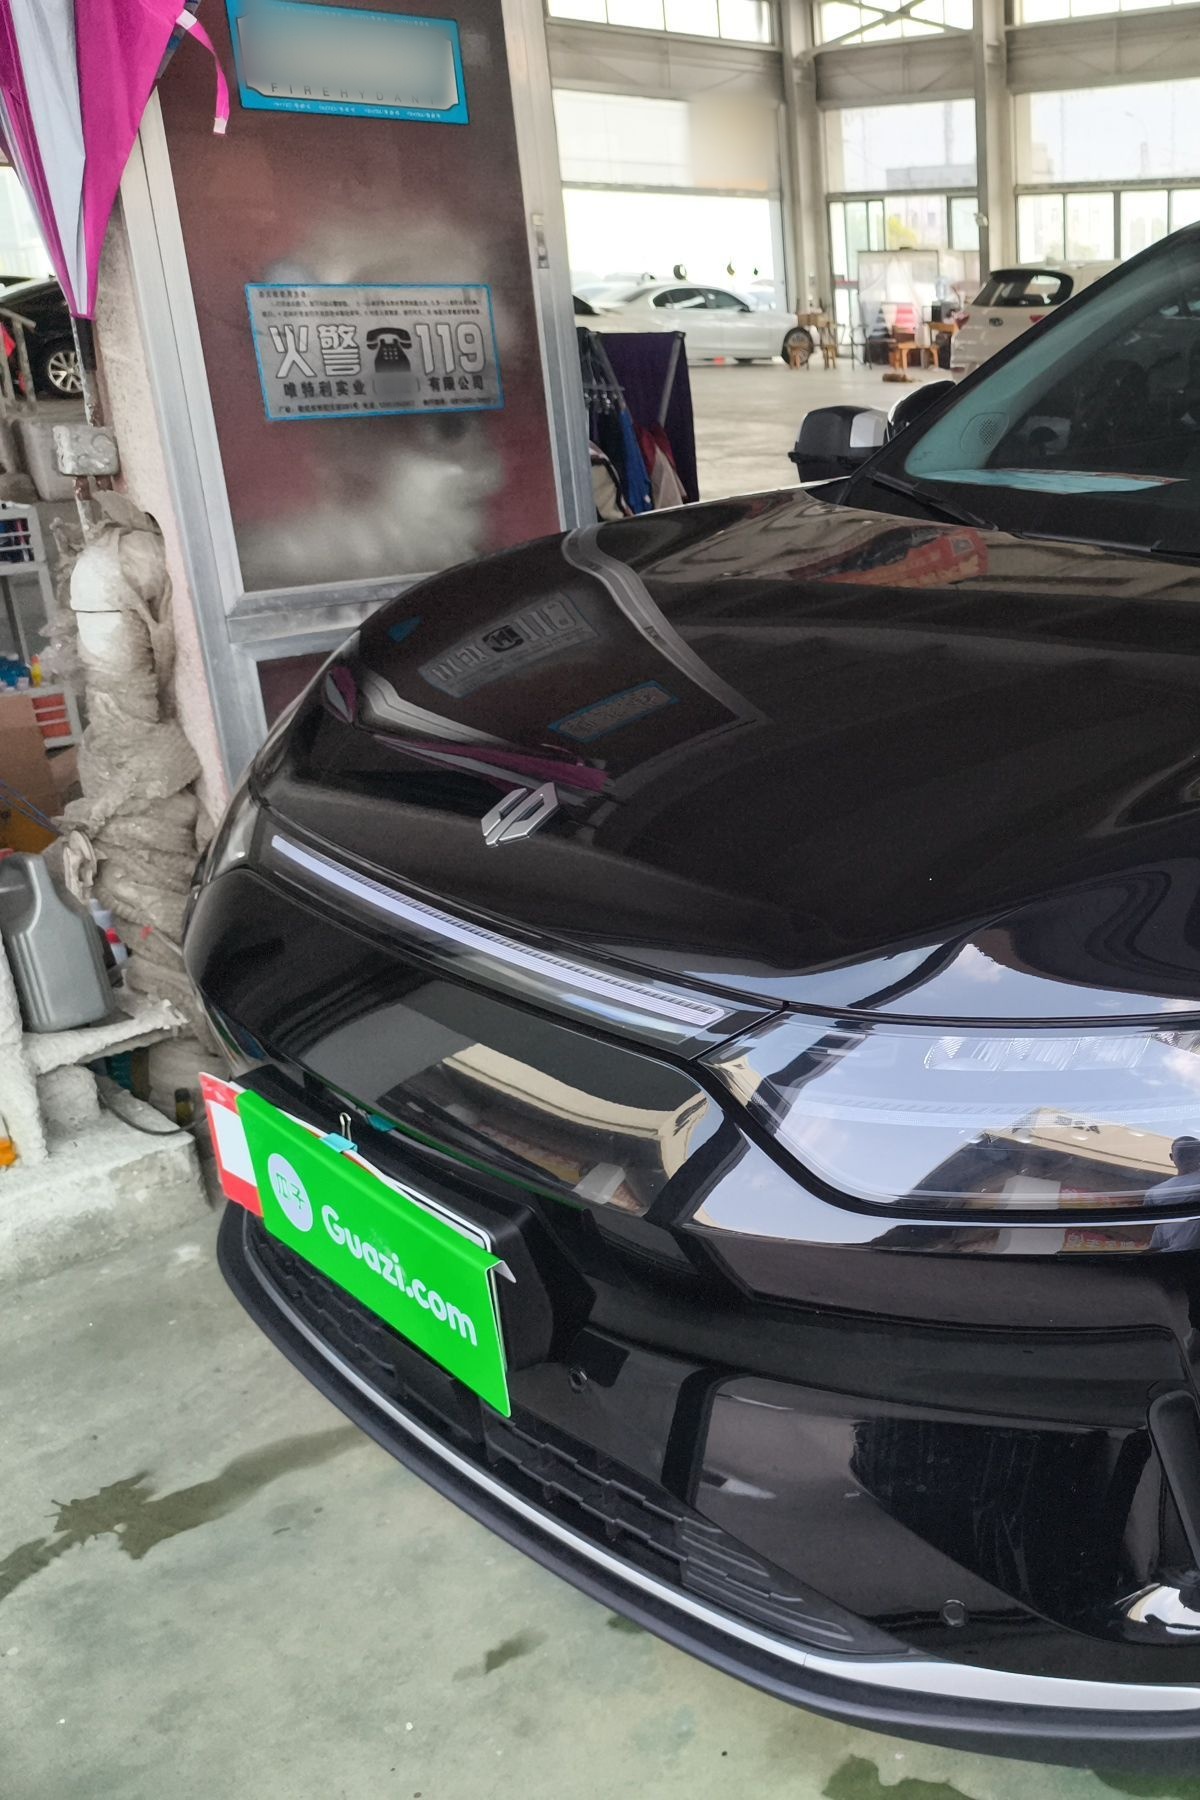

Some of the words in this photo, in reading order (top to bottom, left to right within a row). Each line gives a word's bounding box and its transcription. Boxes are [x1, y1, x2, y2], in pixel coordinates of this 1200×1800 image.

[267, 323, 363, 379] 火警
[413, 321, 487, 376] 119
[427, 375, 485, 393] 有限公司
[275, 1172, 305, 1210] 瓜子
[321, 1204, 478, 1347] Guazi.com
